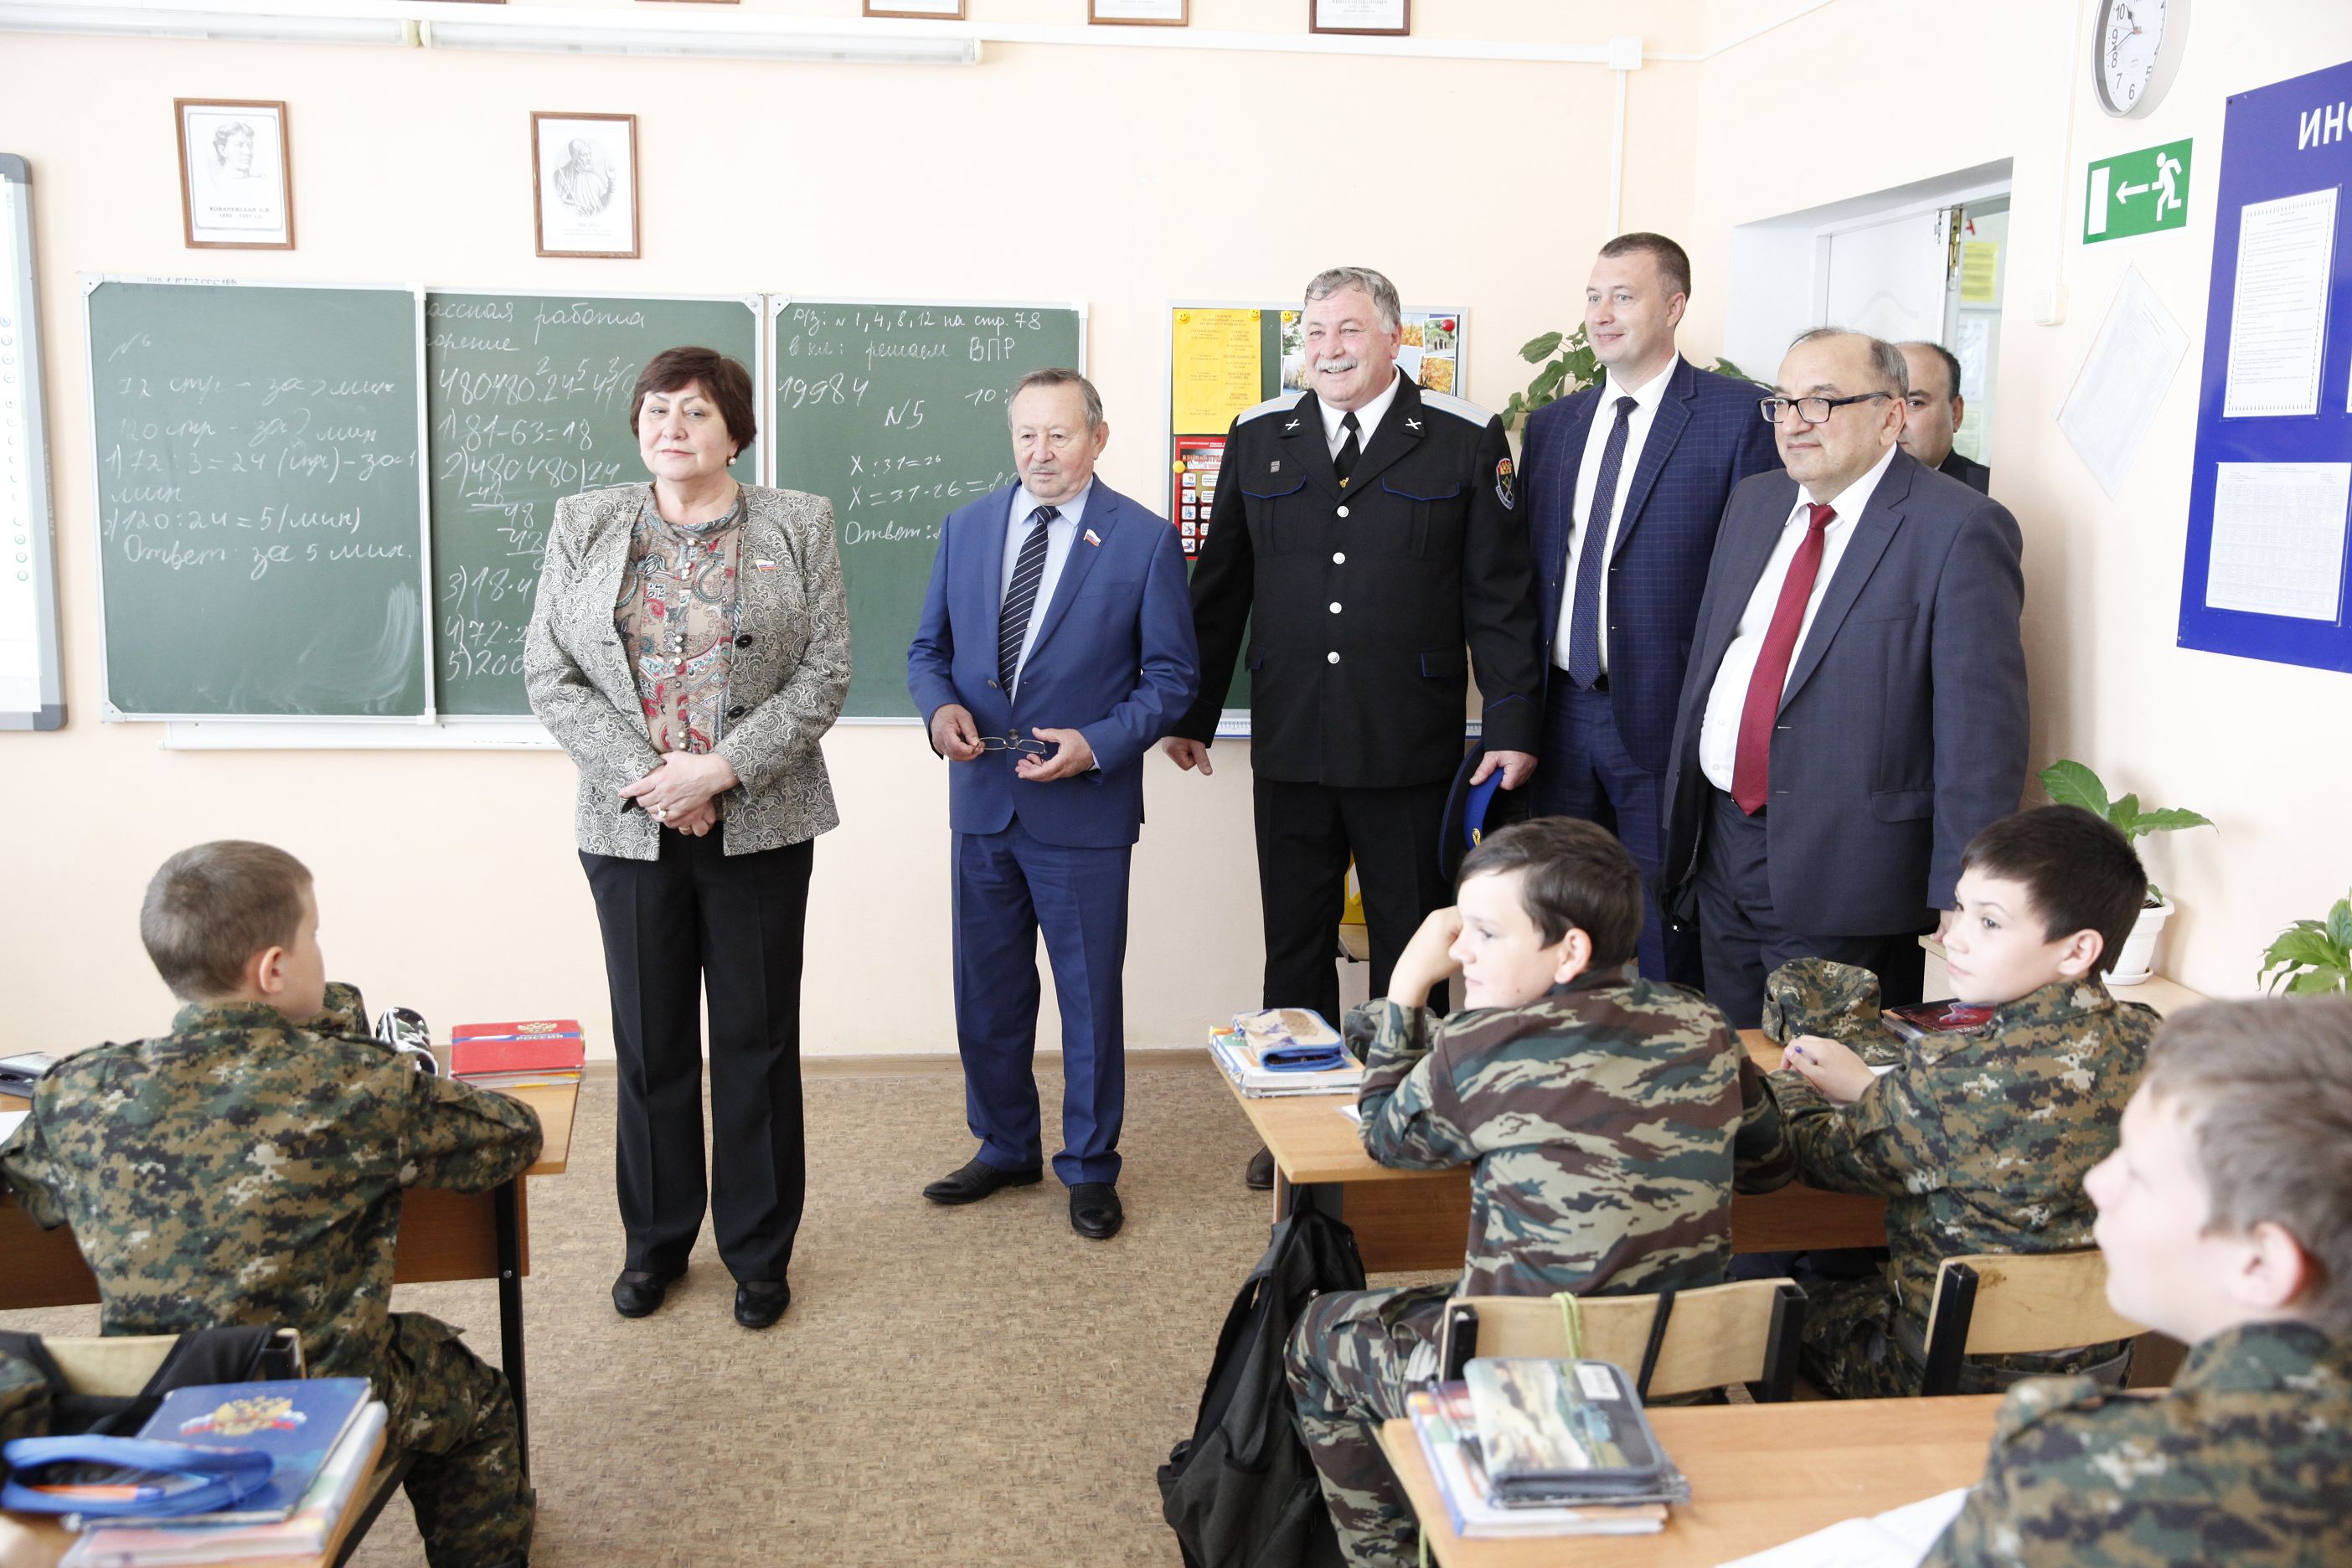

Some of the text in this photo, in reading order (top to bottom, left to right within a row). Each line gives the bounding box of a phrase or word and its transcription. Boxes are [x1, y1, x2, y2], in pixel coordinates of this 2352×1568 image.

[2116, 3, 2126, 21] 10
[2112, 28, 2118, 45] 9
[2111, 51, 2118, 69] 8
[2116, 72, 2123, 90] 7
[2128, 83, 2136, 101] 6
[426, 301, 645, 345] ассная работа
[943, 314, 966, 328] на
[1014, 311, 1042, 330] 78
[426, 333, 521, 363] орение
[969, 336, 1016, 363] ВПР
[251, 544, 297, 581] за
[305, 542, 318, 563] 5
